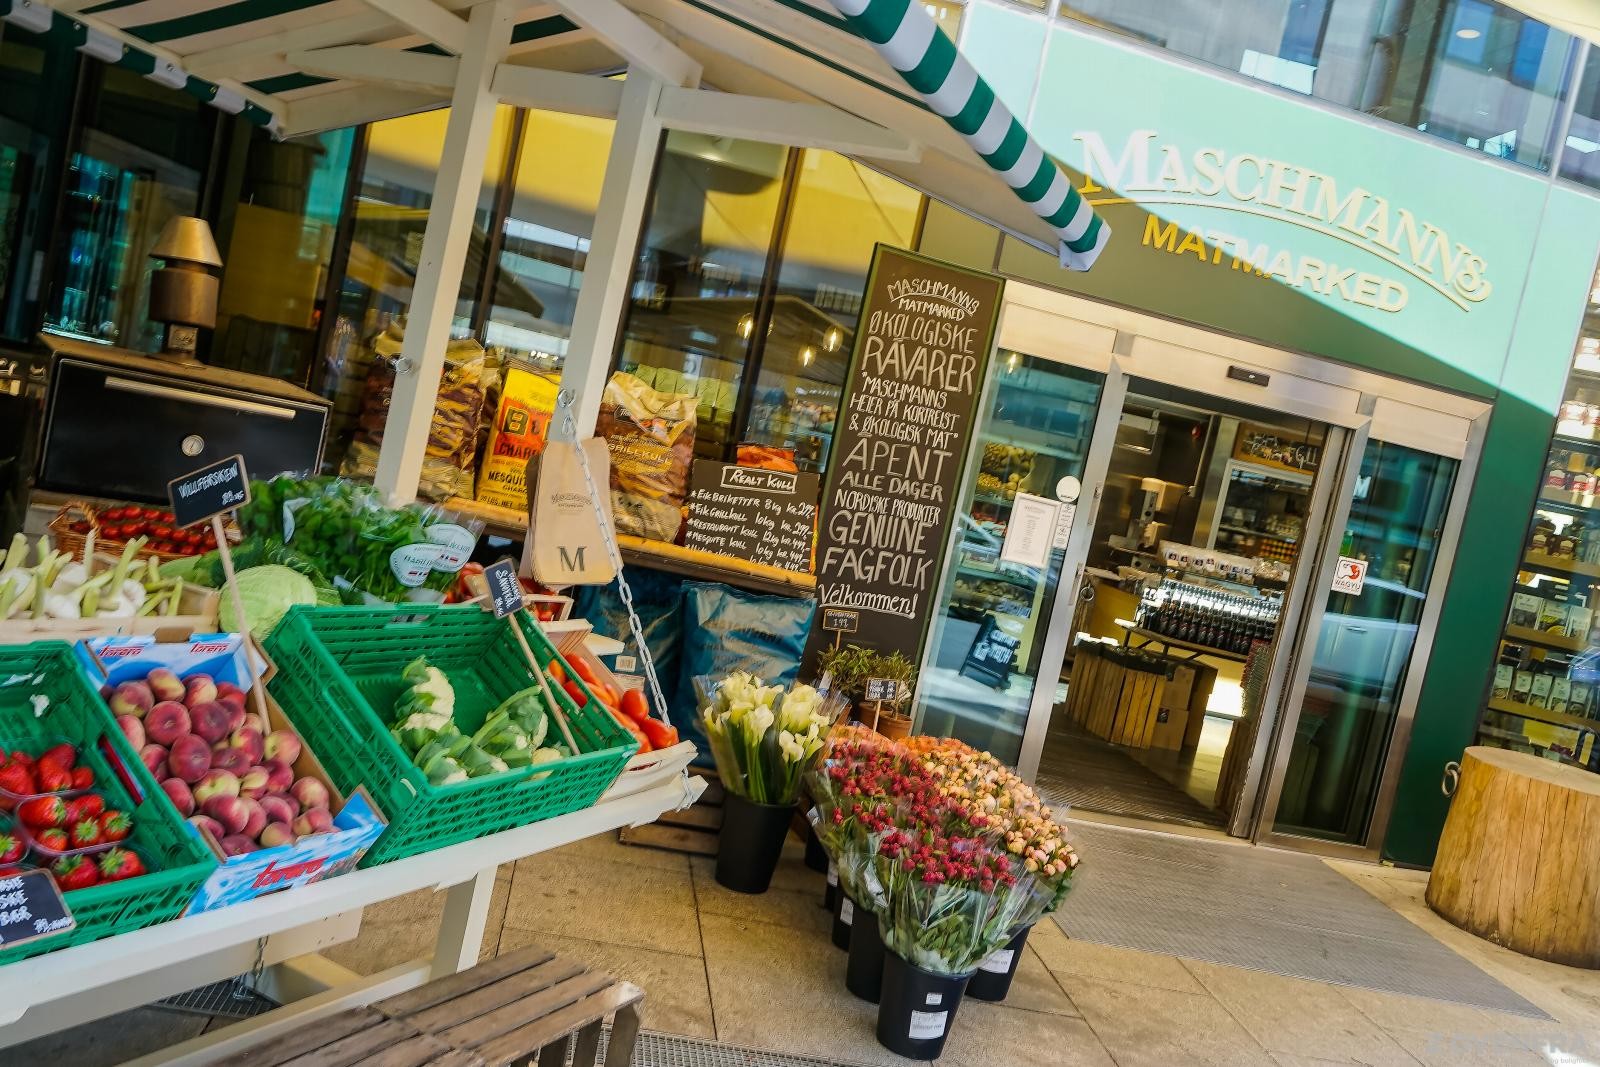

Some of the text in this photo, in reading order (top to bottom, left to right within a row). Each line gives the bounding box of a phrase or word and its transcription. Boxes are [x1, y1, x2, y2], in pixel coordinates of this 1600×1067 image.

[1141, 214, 1409, 314] MATMARKED
[887, 278, 979, 314] MASCHMANNS
[898, 298, 965, 321] MATMARKED
[868, 311, 978, 354] ØKOLOGISKE
[849, 413, 859, 430] &
[862, 416, 920, 443] ØKOLOGISK
[850, 392, 883, 418] HEIER
[903, 404, 960, 430] KORTREIST
[842, 434, 952, 485] ÅPENT
[840, 471, 943, 502] ALLE DAGER
[834, 488, 941, 526] NORDISKE PRODUKTER
[829, 510, 933, 554] GENUINE
[557, 545, 588, 572] M
[821, 547, 934, 591] FAGFOLK
[818, 583, 918, 619] Velkommen!
